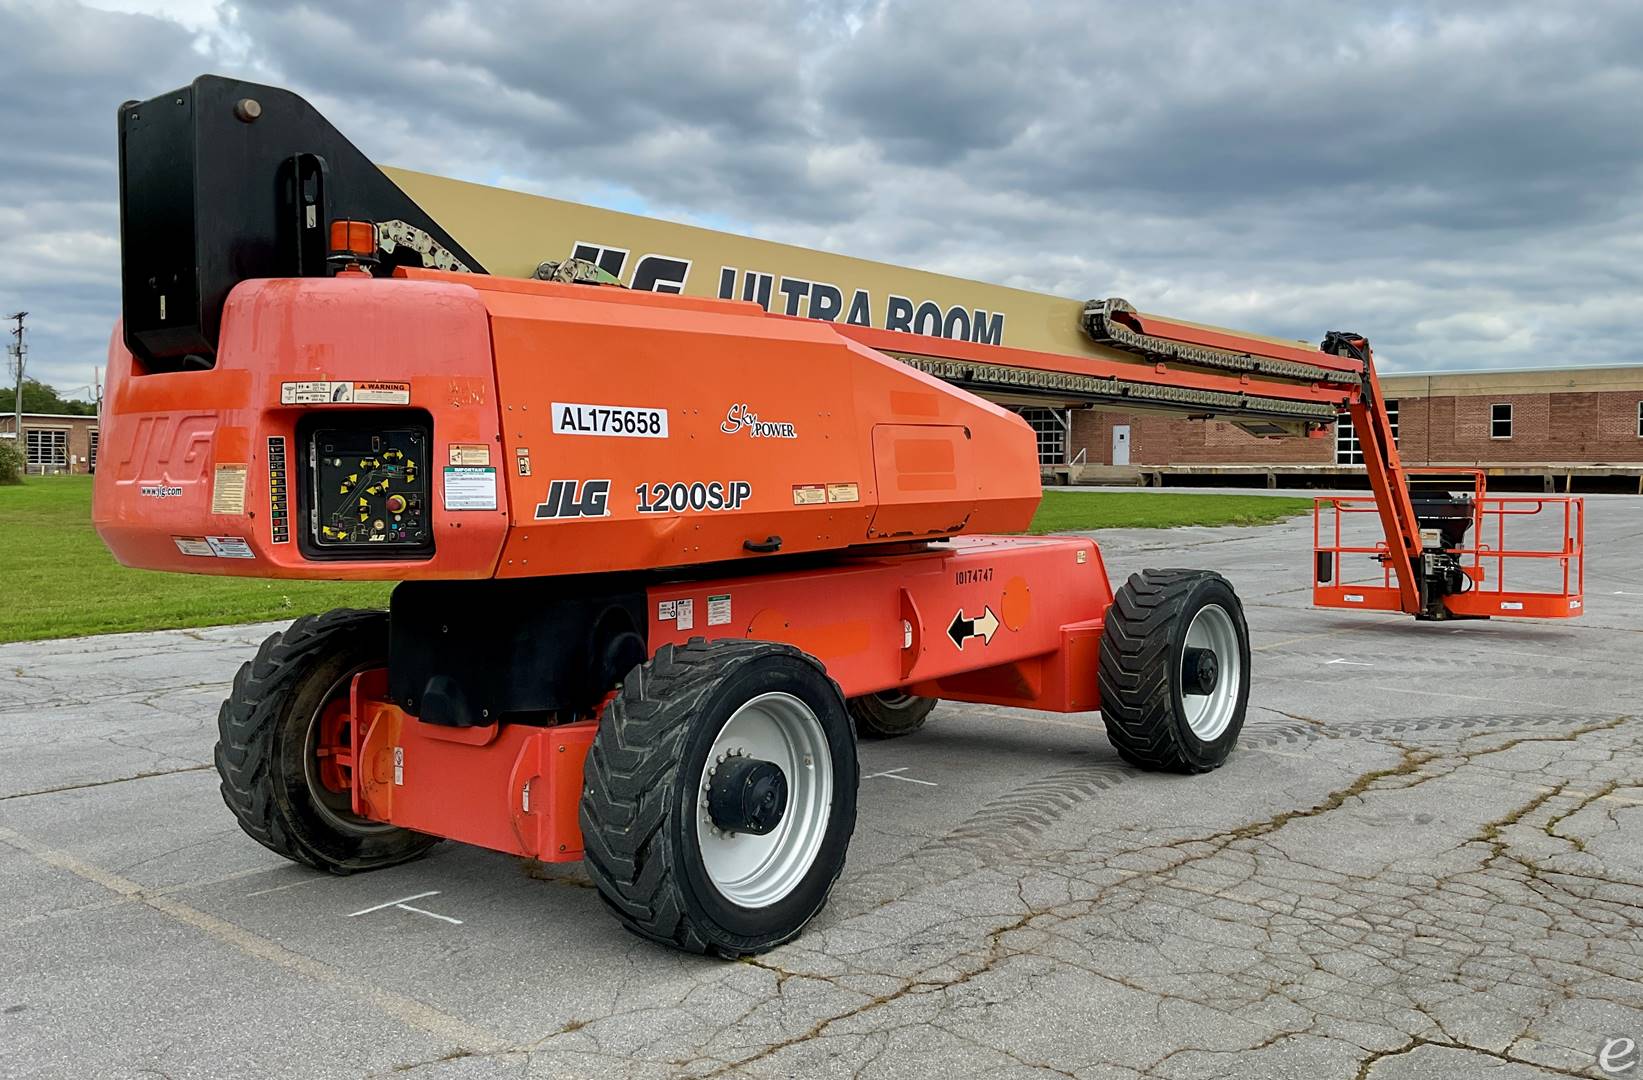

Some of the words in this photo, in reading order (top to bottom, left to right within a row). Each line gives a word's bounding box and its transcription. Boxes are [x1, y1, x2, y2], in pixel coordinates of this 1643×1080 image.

[885, 294, 1005, 346] BOOM
[560, 407, 661, 434] AL175658
[721, 405, 757, 436] Sky
[755, 422, 794, 437] POWER
[116, 414, 218, 486] JLG
[141, 486, 182, 498] www.jlg.com
[534, 480, 611, 519] JLG
[635, 482, 752, 512] 1200SJP
[956, 568, 993, 585] 10174747
